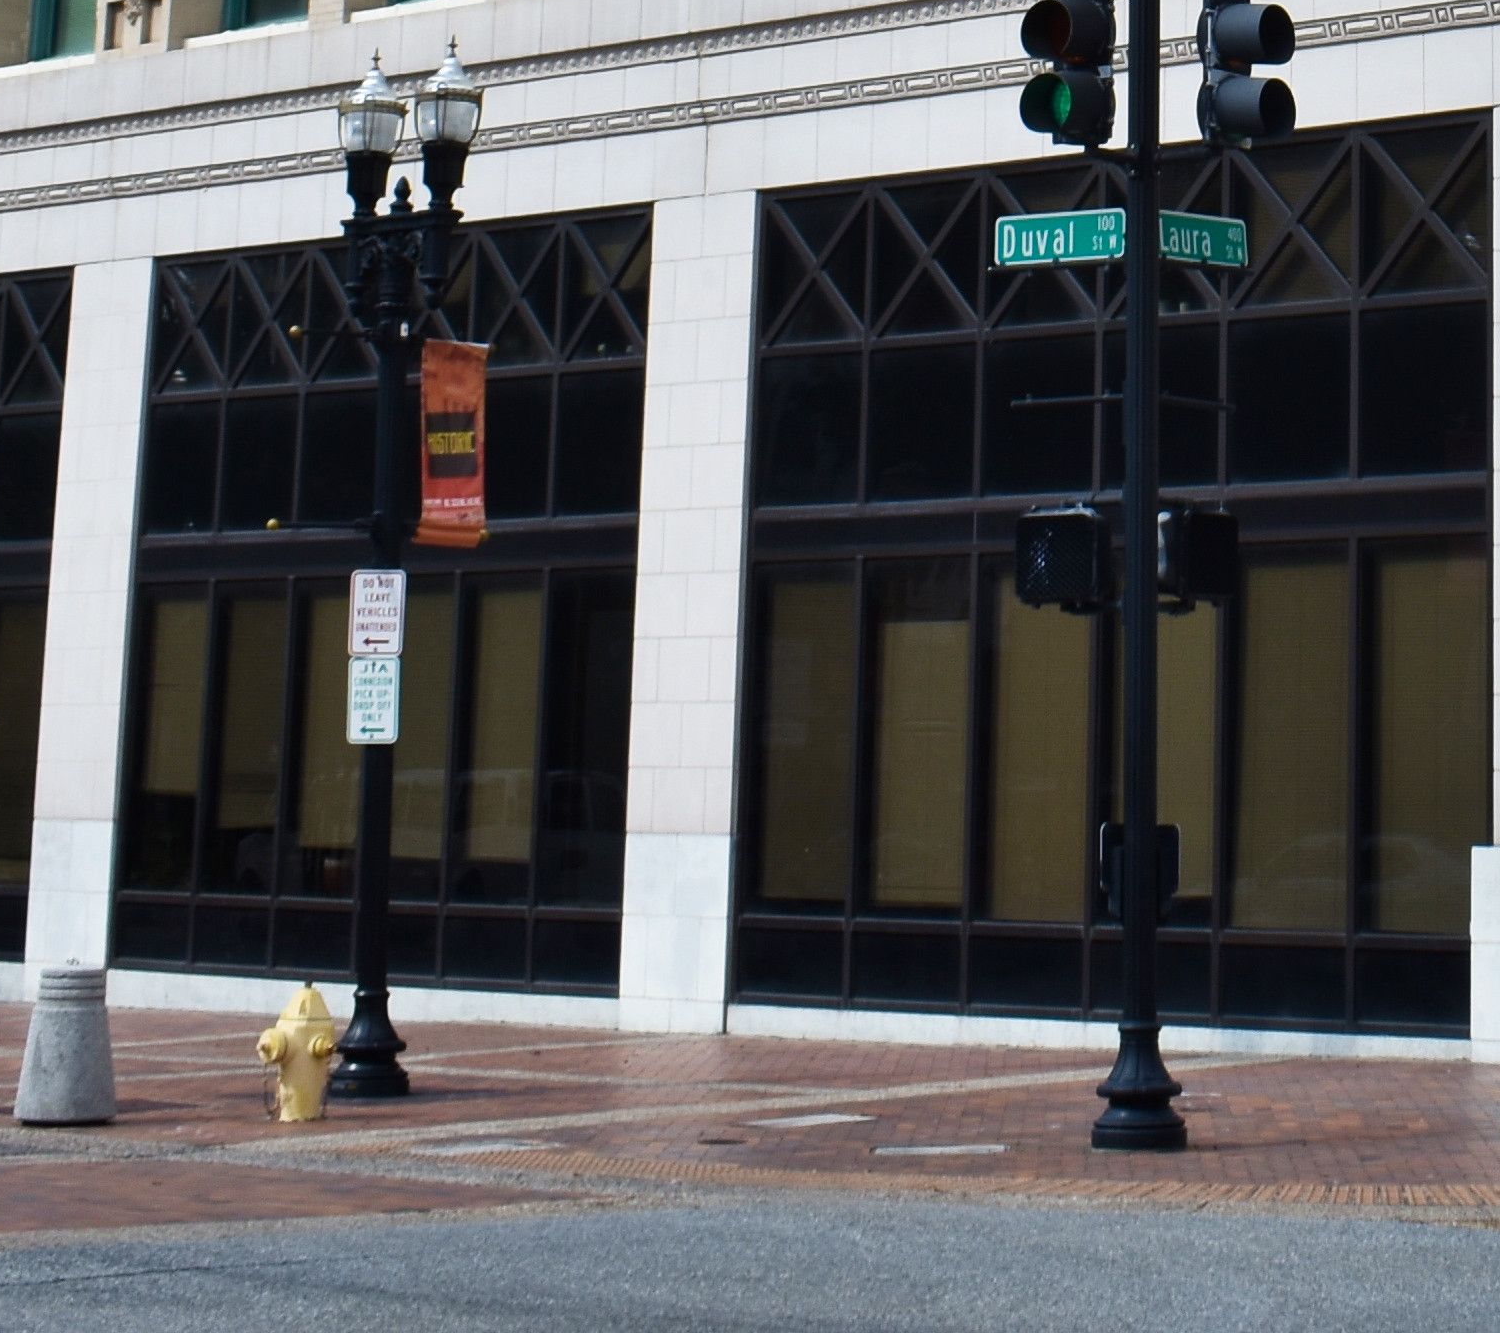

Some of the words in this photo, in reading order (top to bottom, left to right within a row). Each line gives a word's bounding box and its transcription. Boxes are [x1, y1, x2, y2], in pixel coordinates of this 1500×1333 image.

[1097, 215, 1116, 231] 100
[1003, 220, 1074, 259] Duval
[1091, 235, 1102, 251] St
[1109, 234, 1117, 250] W
[1158, 217, 1212, 257] Laura
[427, 431, 476, 455] HISTORIC
[362, 578, 375, 589] DO
[377, 578, 395, 589] NOT
[364, 593, 391, 603] LEAVE
[356, 607, 398, 618] VEHICLES
[356, 622, 397, 632] UNATTENDED
[361, 662, 388, 673] JTA
[354, 689, 373, 699] PICK
[353, 701, 374, 711] DROP
[377, 701, 391, 711] OFF
[361, 713, 383, 723] ONLY
